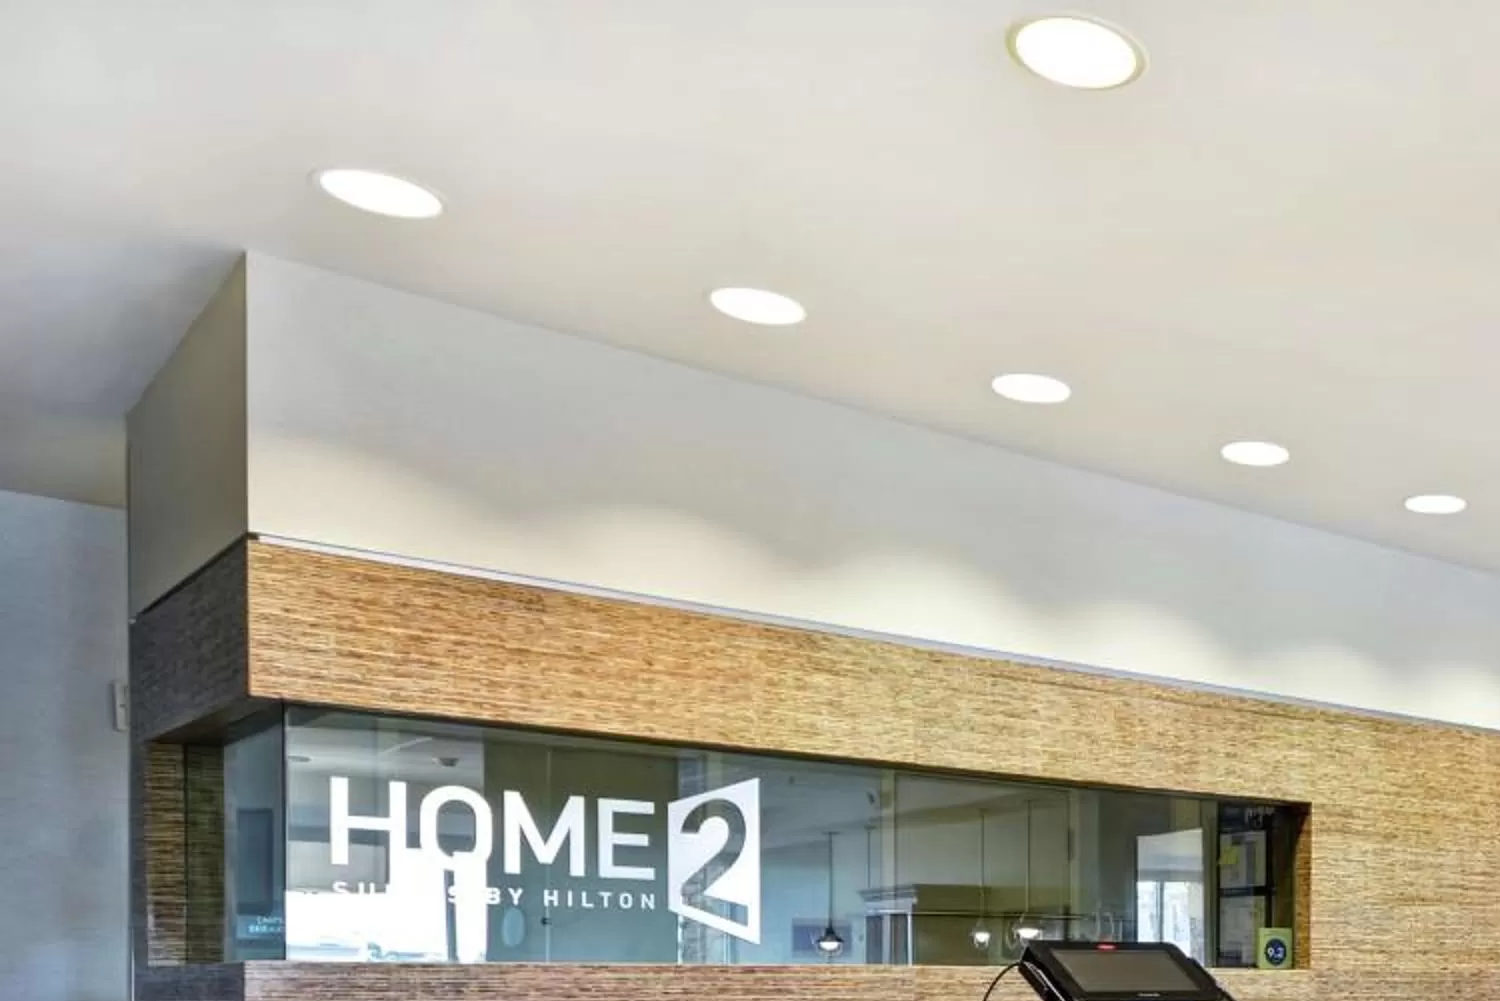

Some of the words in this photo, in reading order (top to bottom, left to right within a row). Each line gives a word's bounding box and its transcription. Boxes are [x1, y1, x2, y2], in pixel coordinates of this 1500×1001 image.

[329, 775, 656, 881] HOME
[485, 887, 523, 906] BY
[543, 889, 656, 910] HILTON
